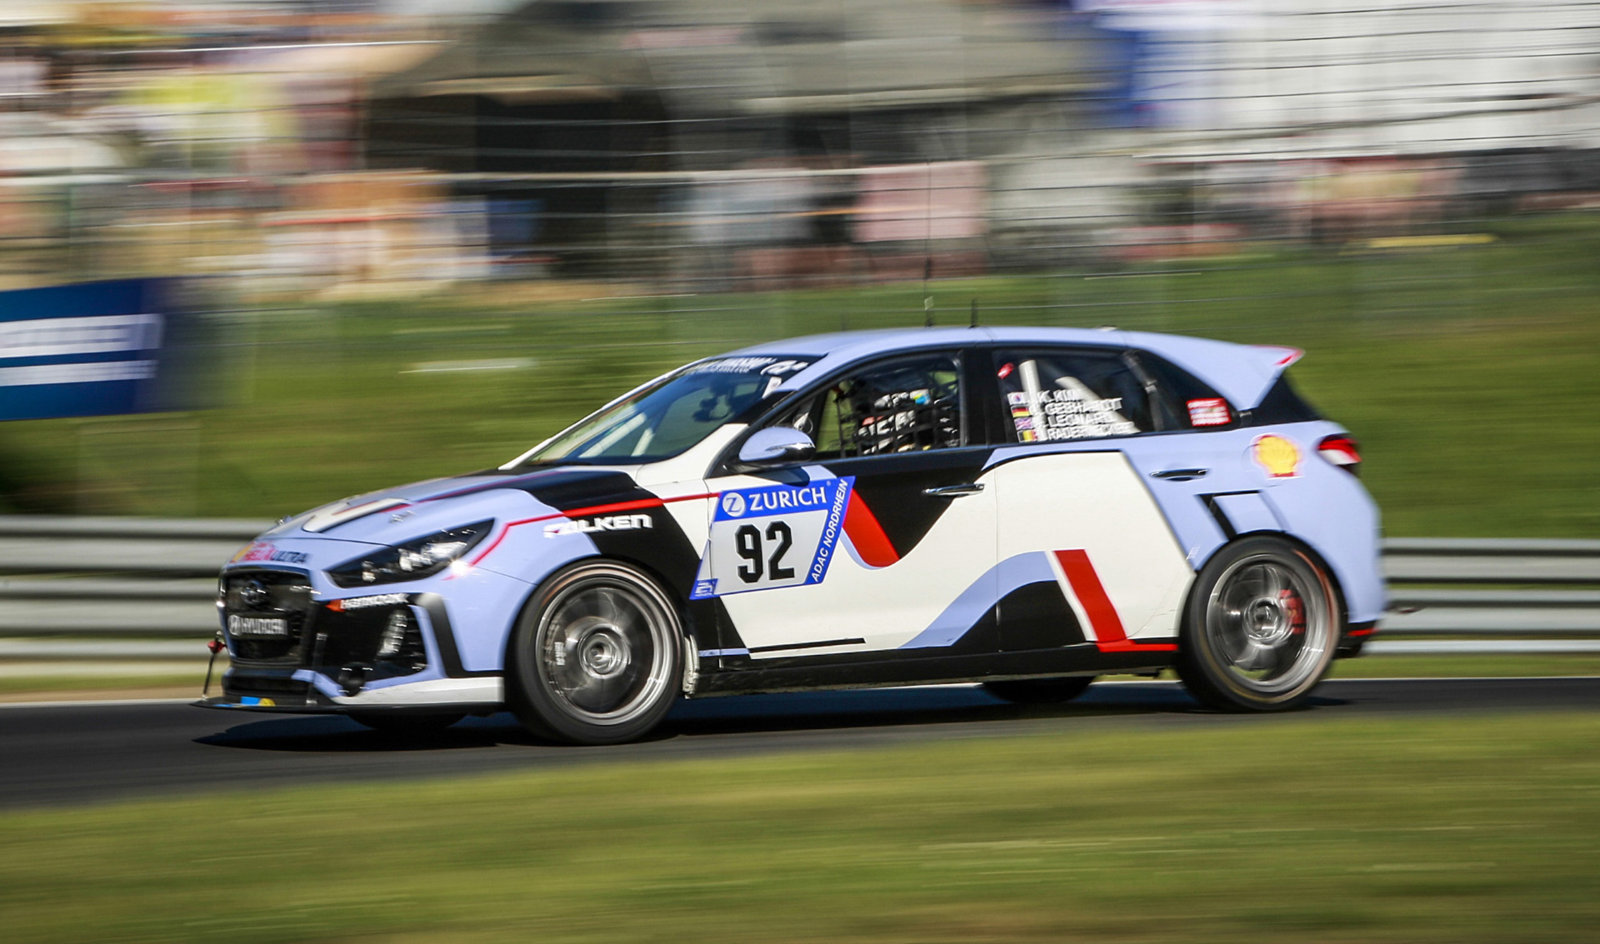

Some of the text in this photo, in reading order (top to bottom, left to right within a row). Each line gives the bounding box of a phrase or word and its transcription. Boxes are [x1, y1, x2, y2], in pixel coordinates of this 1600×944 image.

[748, 486, 827, 511] ZURICH
[543, 514, 653, 539] FALKEN
[811, 479, 849, 583] ADAC NORDRHEIN
[271, 550, 308, 564] ULTRA
[734, 520, 796, 584] 92
